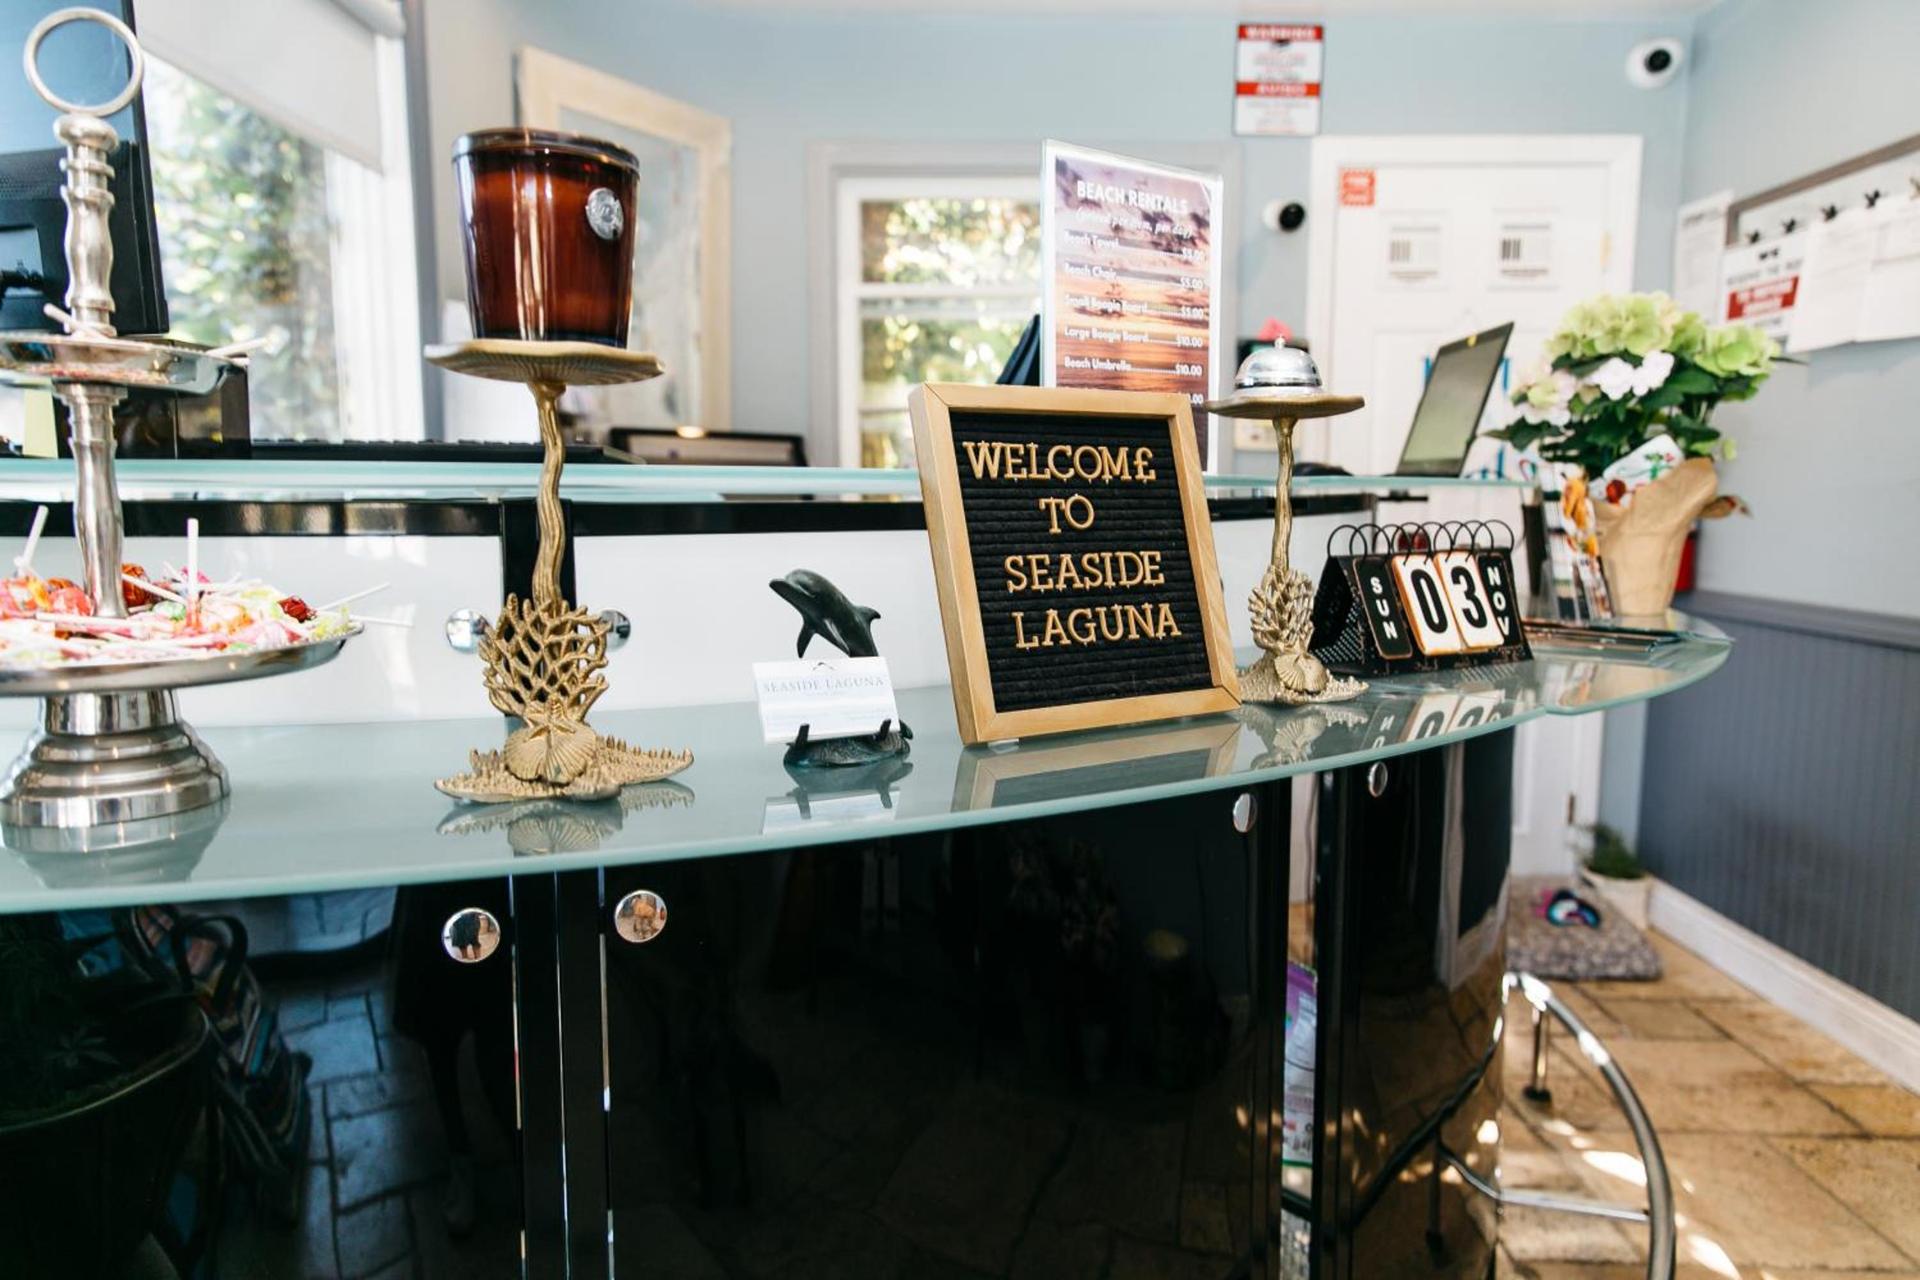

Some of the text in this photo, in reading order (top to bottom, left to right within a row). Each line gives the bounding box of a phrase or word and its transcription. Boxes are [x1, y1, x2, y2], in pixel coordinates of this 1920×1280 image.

[1076, 180, 1188, 214] BEACH RENTALS
[1064, 231, 1090, 246] Beach
[1064, 263, 1090, 277] Beach
[1093, 266, 1117, 281] Chair
[1064, 326, 1089, 342] Large
[1092, 328, 1120, 343] Boogie
[1177, 335, 1202, 347] $10.00
[1064, 357, 1202, 375] Beach Umbrella $10.00
[1039, 493, 1095, 535] TO
[1004, 550, 1165, 592] SEASIDE
[1369, 576, 1399, 640] SUN
[1486, 566, 1510, 636] NOV
[1011, 602, 1182, 650] LAGUNA
[763, 676, 885, 693] SEASIDE LAGUNA
